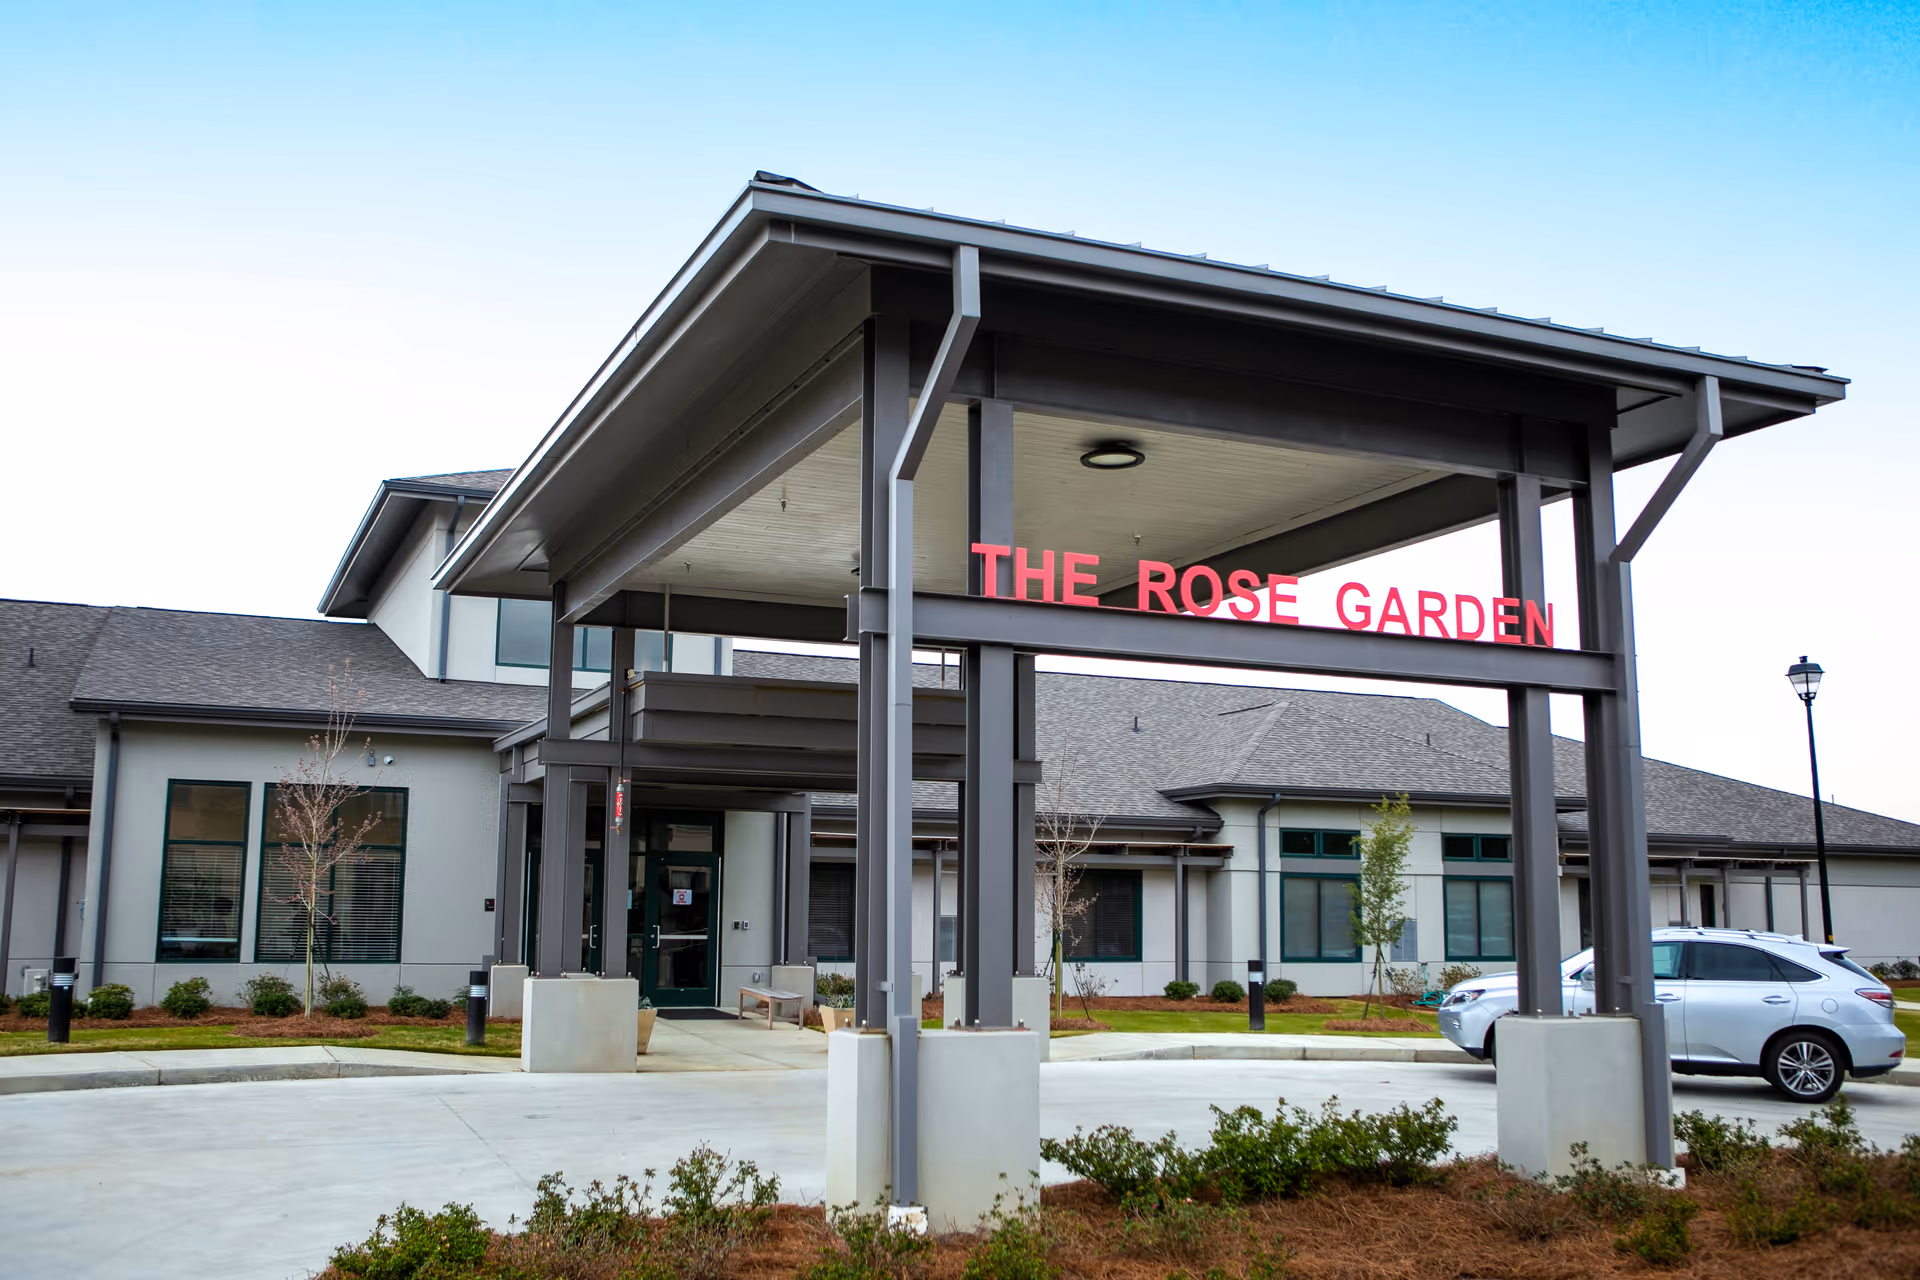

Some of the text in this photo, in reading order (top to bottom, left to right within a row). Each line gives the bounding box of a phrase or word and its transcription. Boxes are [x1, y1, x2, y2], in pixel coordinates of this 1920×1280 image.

[971, 543, 1553, 648] THE ROSE GARDEN
